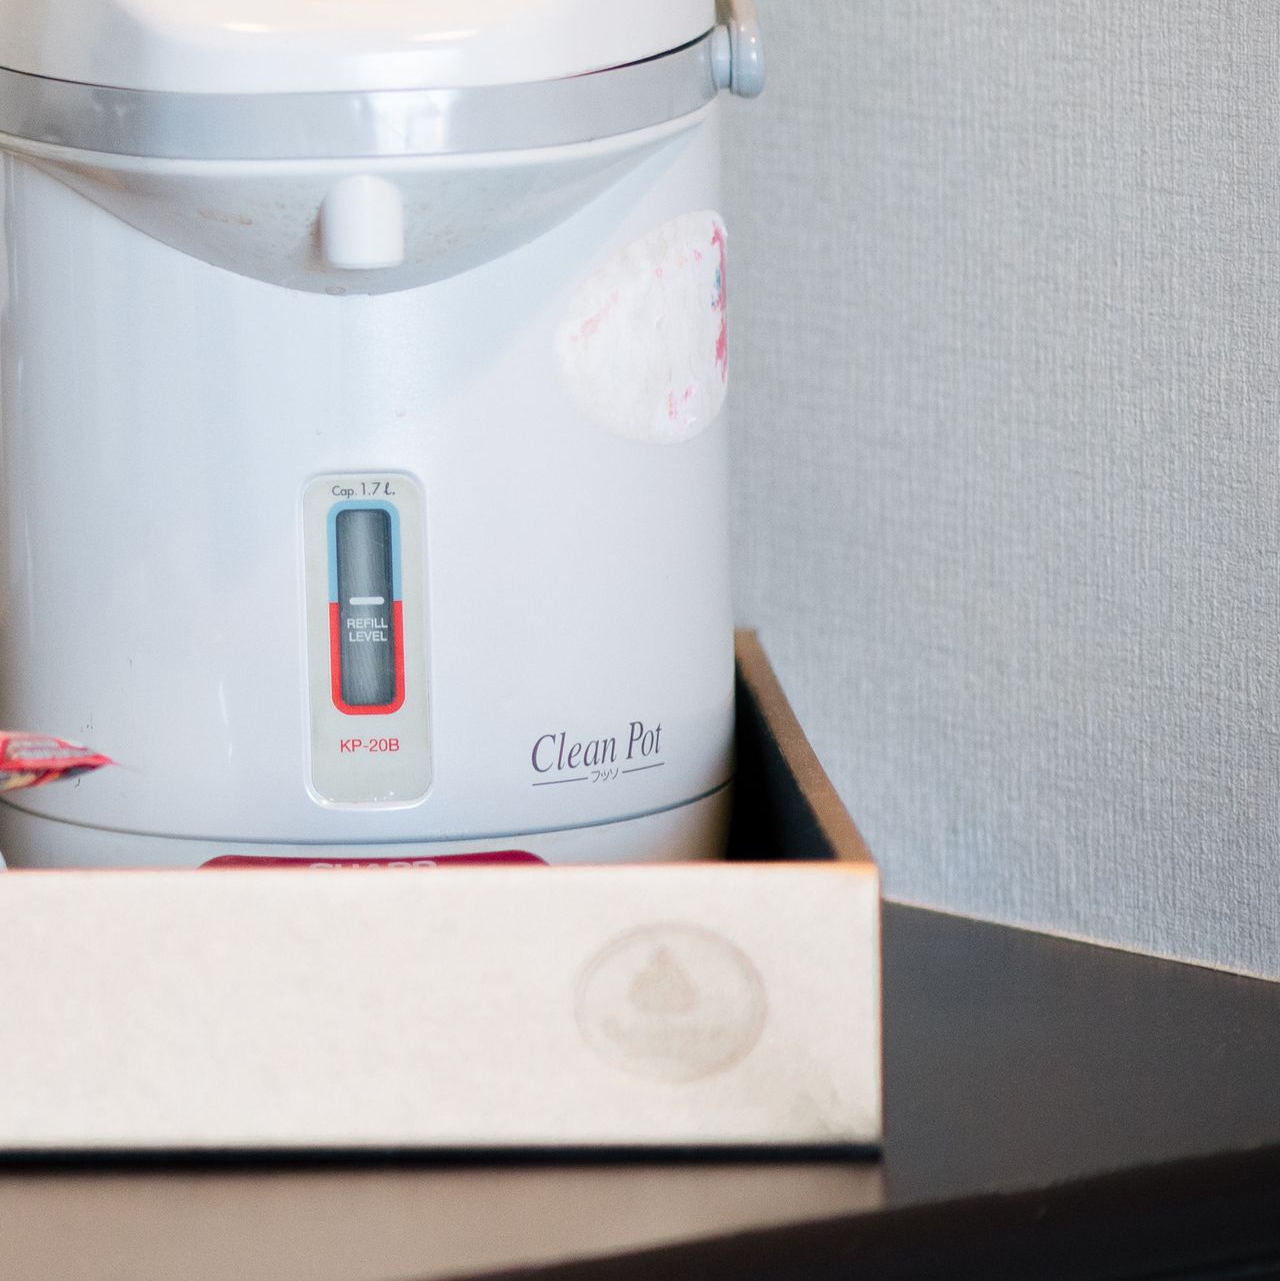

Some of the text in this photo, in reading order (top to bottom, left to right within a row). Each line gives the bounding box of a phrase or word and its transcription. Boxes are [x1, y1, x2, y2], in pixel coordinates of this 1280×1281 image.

[331, 485, 358, 498] Cap.
[361, 482, 381, 495] 1.7
[347, 618, 388, 629] REFILL
[349, 631, 388, 642] LEVEL
[340, 738, 400, 752] KP-20B
[531, 720, 662, 773] Clean Pot
